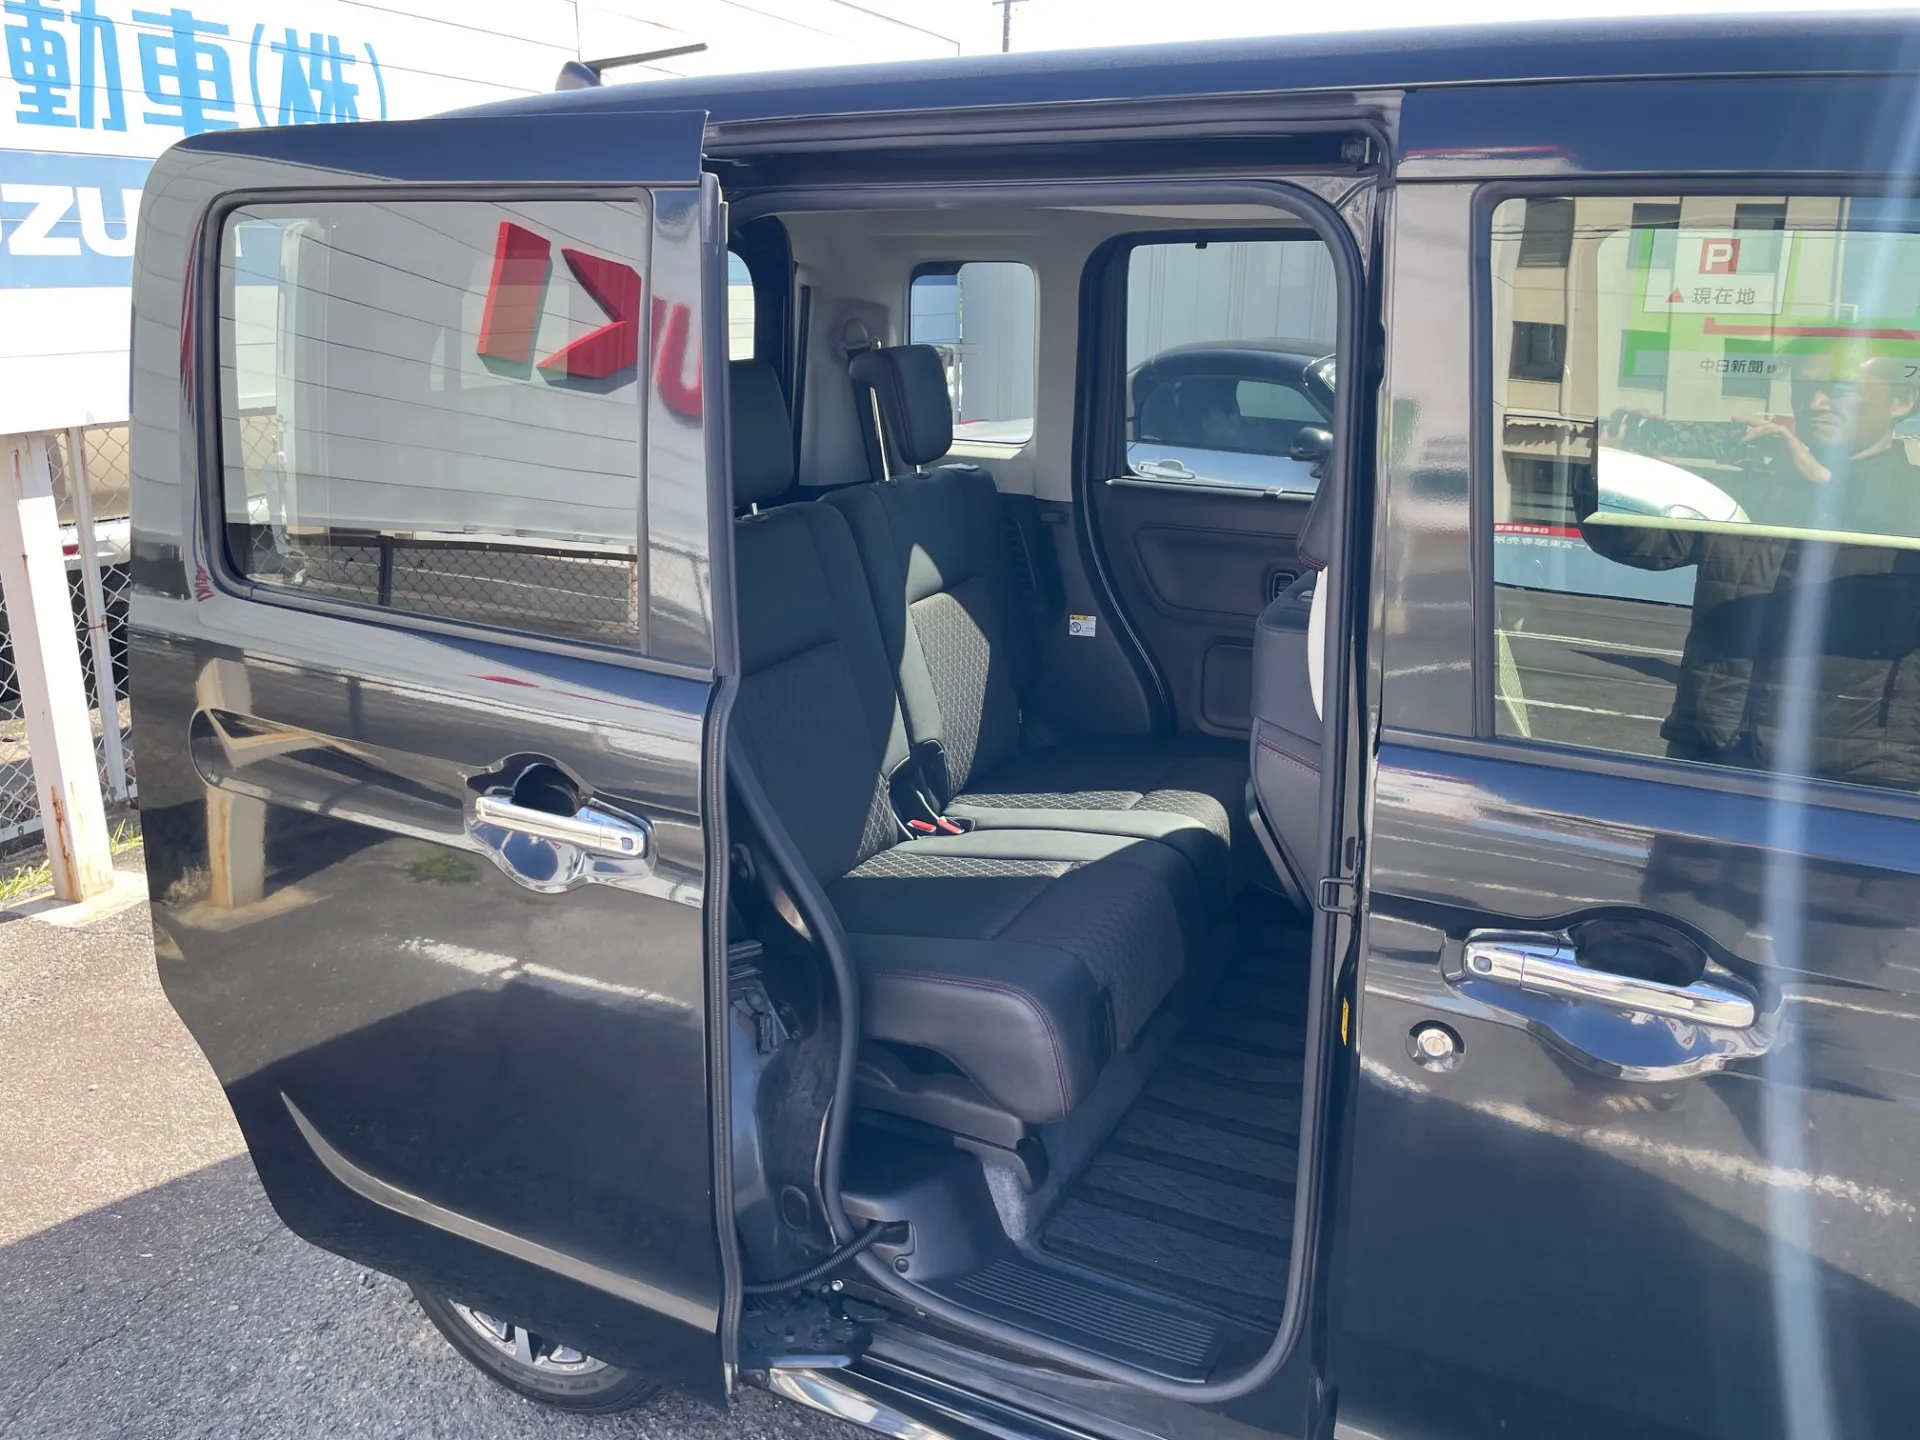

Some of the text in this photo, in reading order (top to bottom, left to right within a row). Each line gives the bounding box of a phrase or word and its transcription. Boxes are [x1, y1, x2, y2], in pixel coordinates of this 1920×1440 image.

[0, 183, 144, 257] ZU
[1704, 243, 1734, 272] P
[1692, 287, 1756, 305] 現在地
